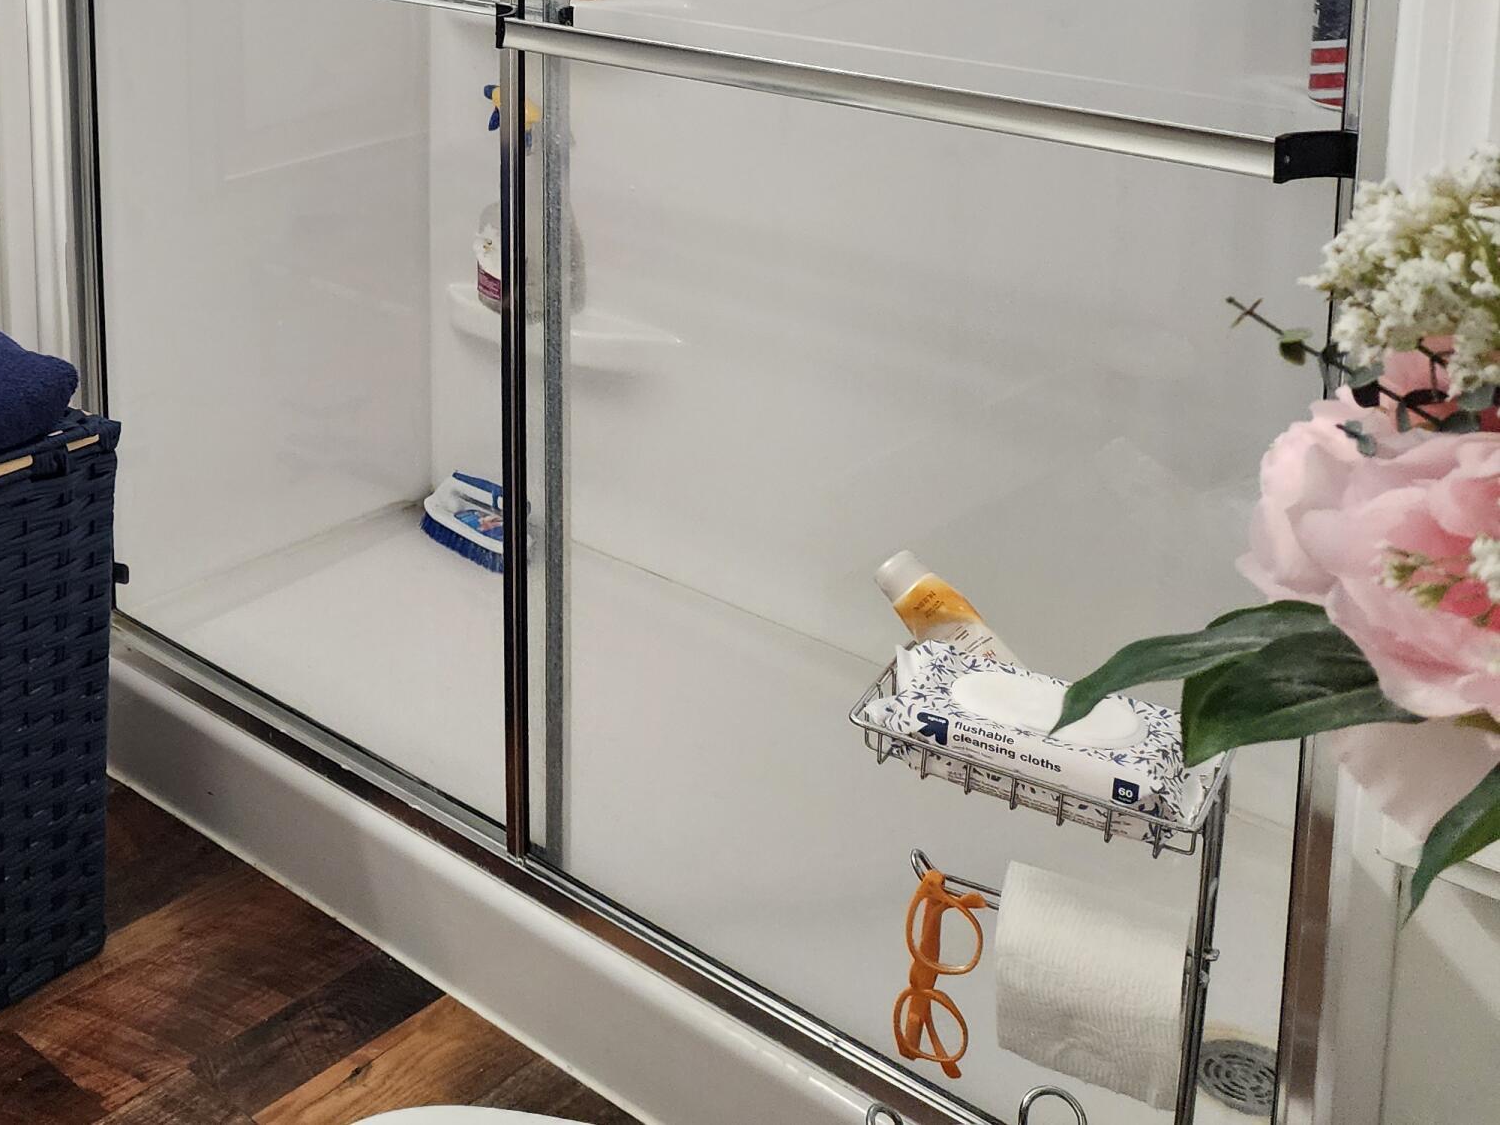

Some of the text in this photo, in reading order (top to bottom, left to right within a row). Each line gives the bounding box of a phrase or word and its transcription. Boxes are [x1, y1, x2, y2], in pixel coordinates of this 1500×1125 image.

[953, 721, 1015, 746] flushable
[951, 732, 1017, 760] cleansing
[1018, 752, 1062, 773] cloths
[1117, 787, 1134, 799] 60
